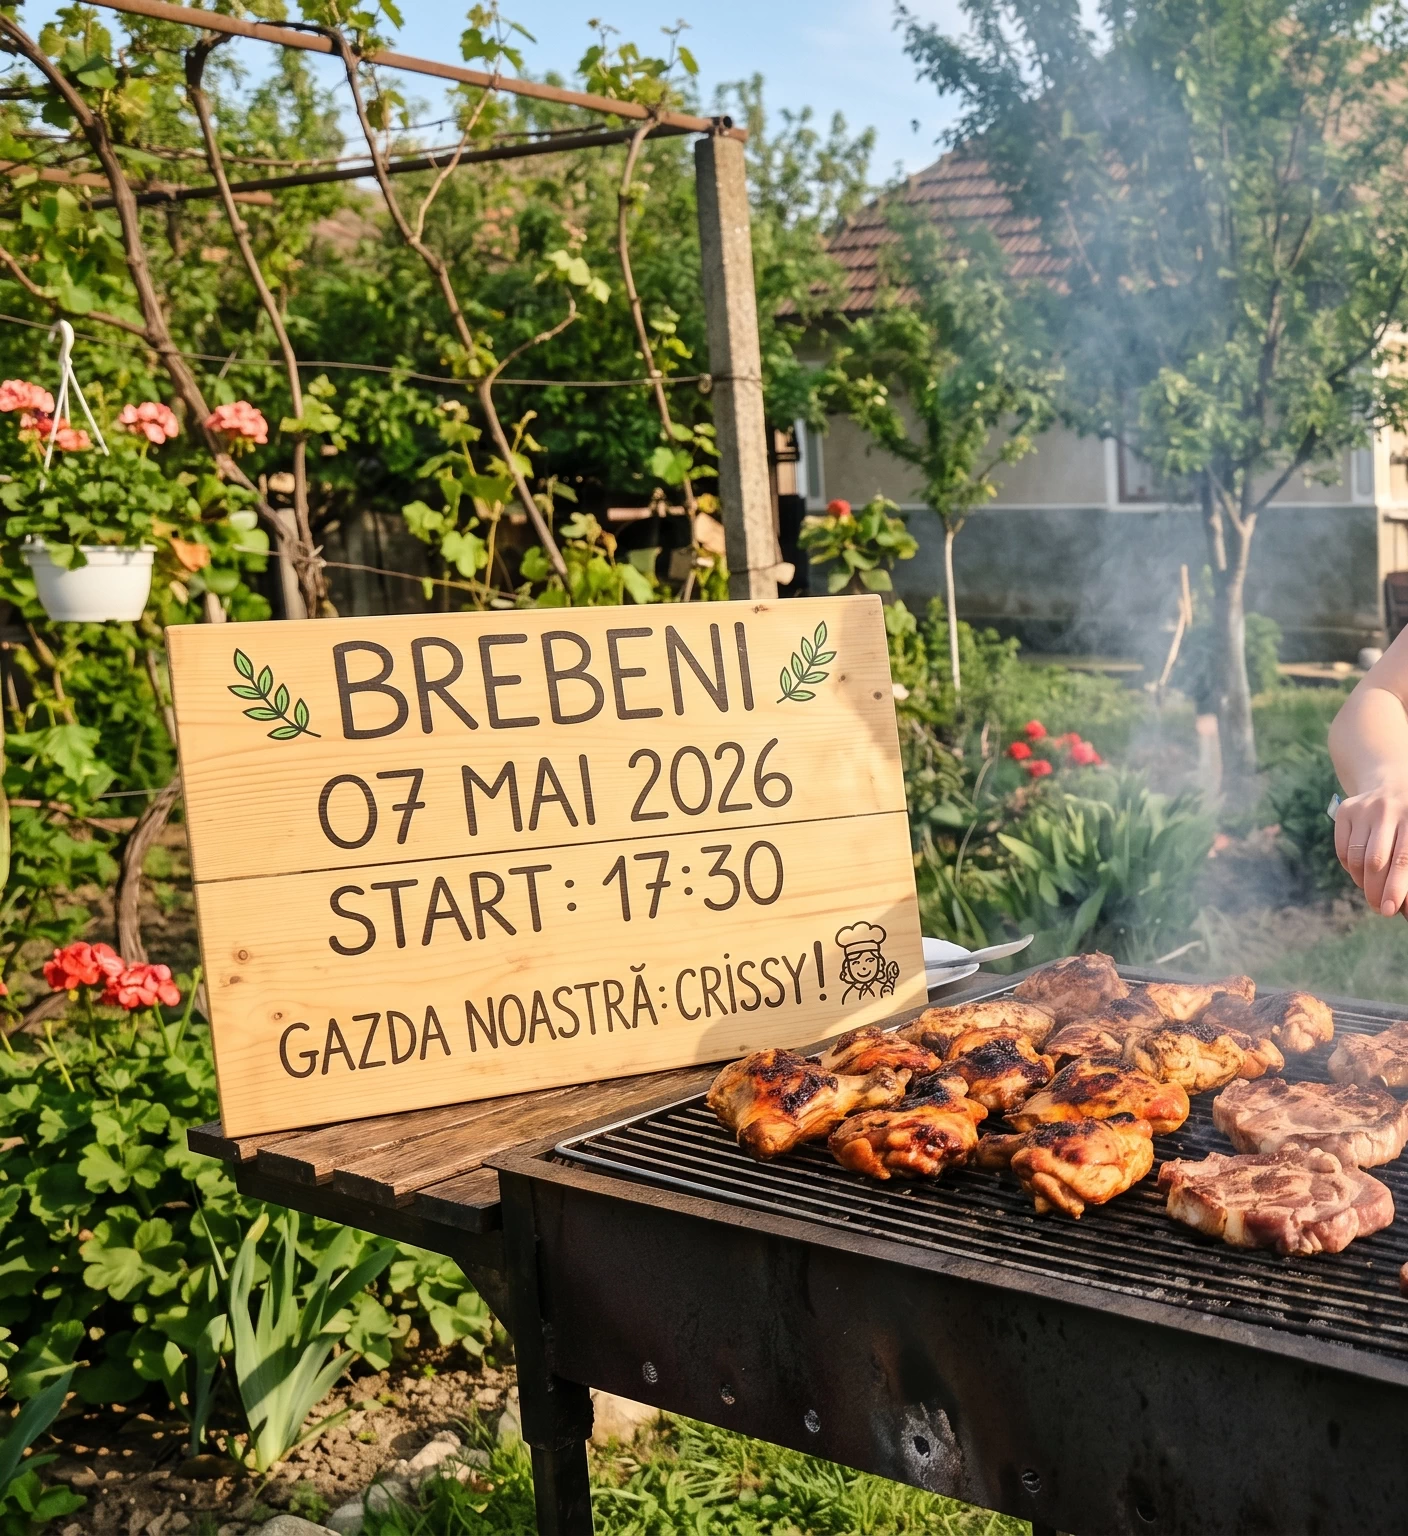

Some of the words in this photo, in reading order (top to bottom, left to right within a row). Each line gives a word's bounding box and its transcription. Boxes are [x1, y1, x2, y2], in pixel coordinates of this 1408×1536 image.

[332, 620, 756, 740] BREBENI
[317, 768, 426, 850] 07
[461, 753, 597, 837] MAI
[628, 737, 793, 822] 2026
[602, 840, 785, 922] 17:30
[279, 1005, 452, 1079] GAZDA
